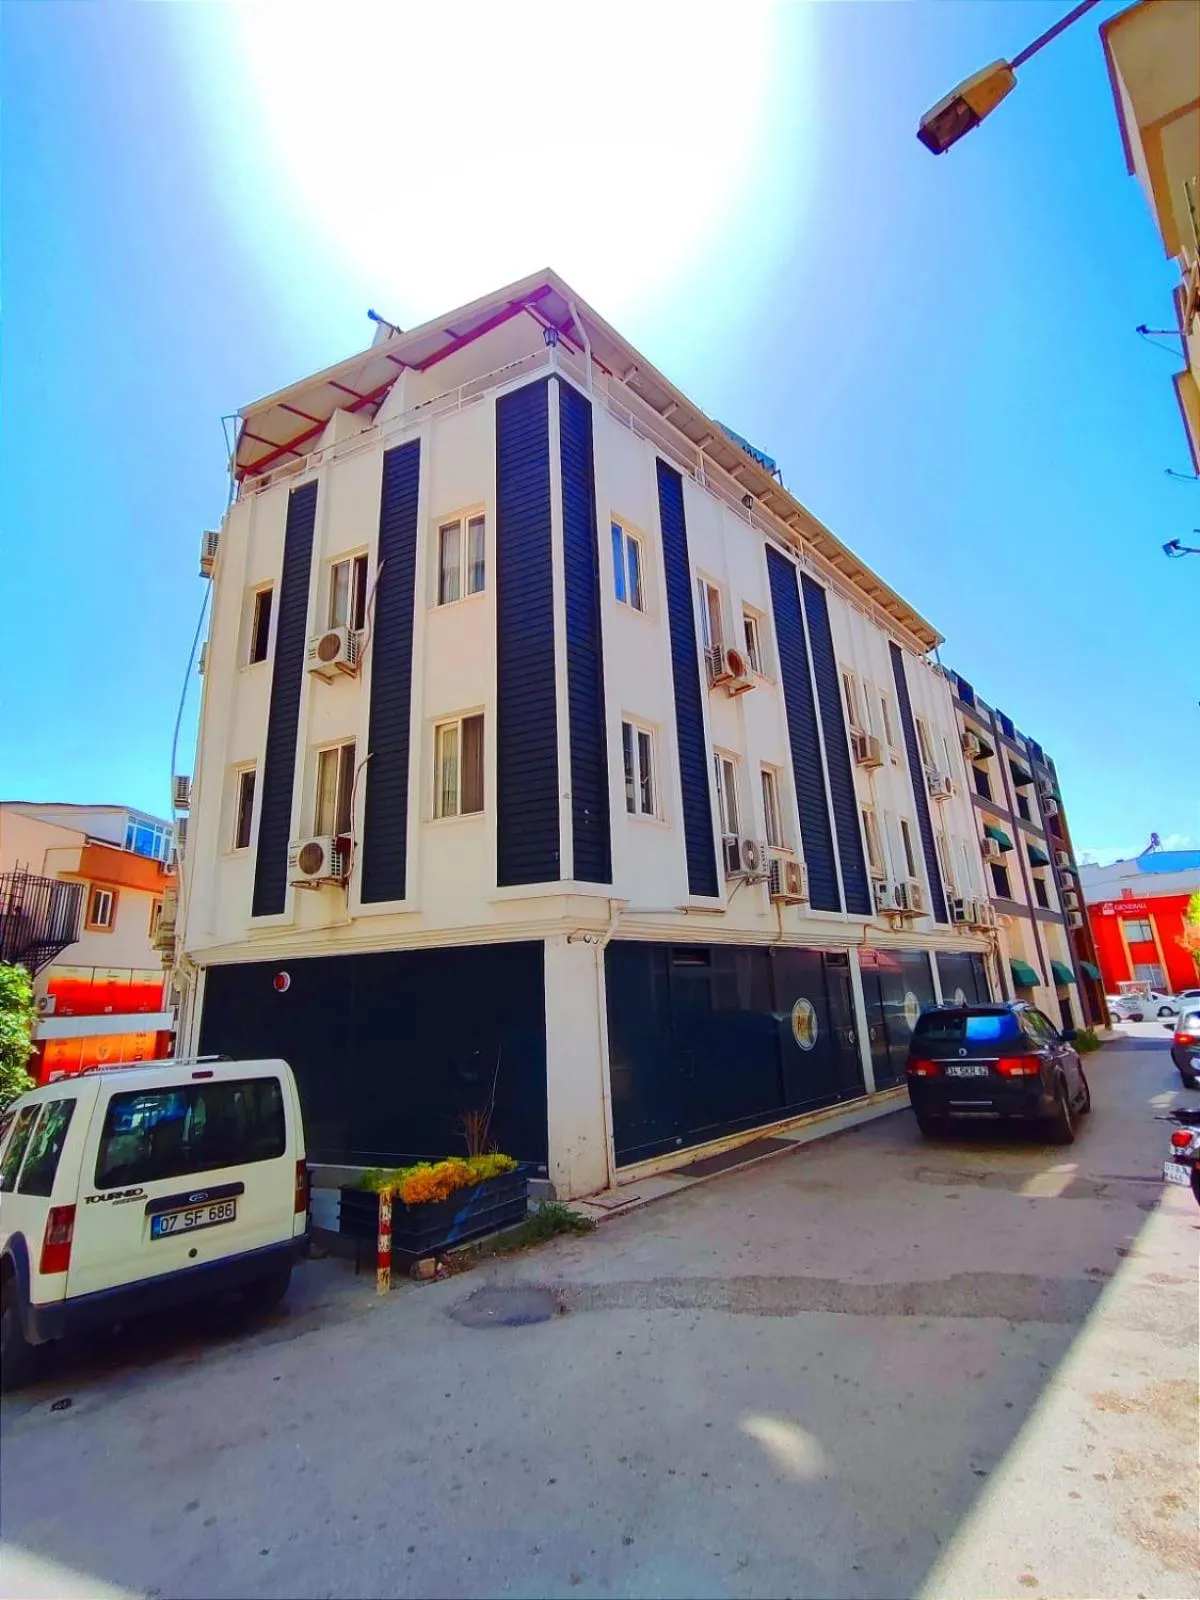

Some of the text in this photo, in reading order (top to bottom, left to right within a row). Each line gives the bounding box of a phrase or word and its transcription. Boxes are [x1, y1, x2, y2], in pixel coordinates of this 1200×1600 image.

[84, 1187, 144, 1205] TOURNEO
[160, 1203, 233, 1232] 07 SF 686
